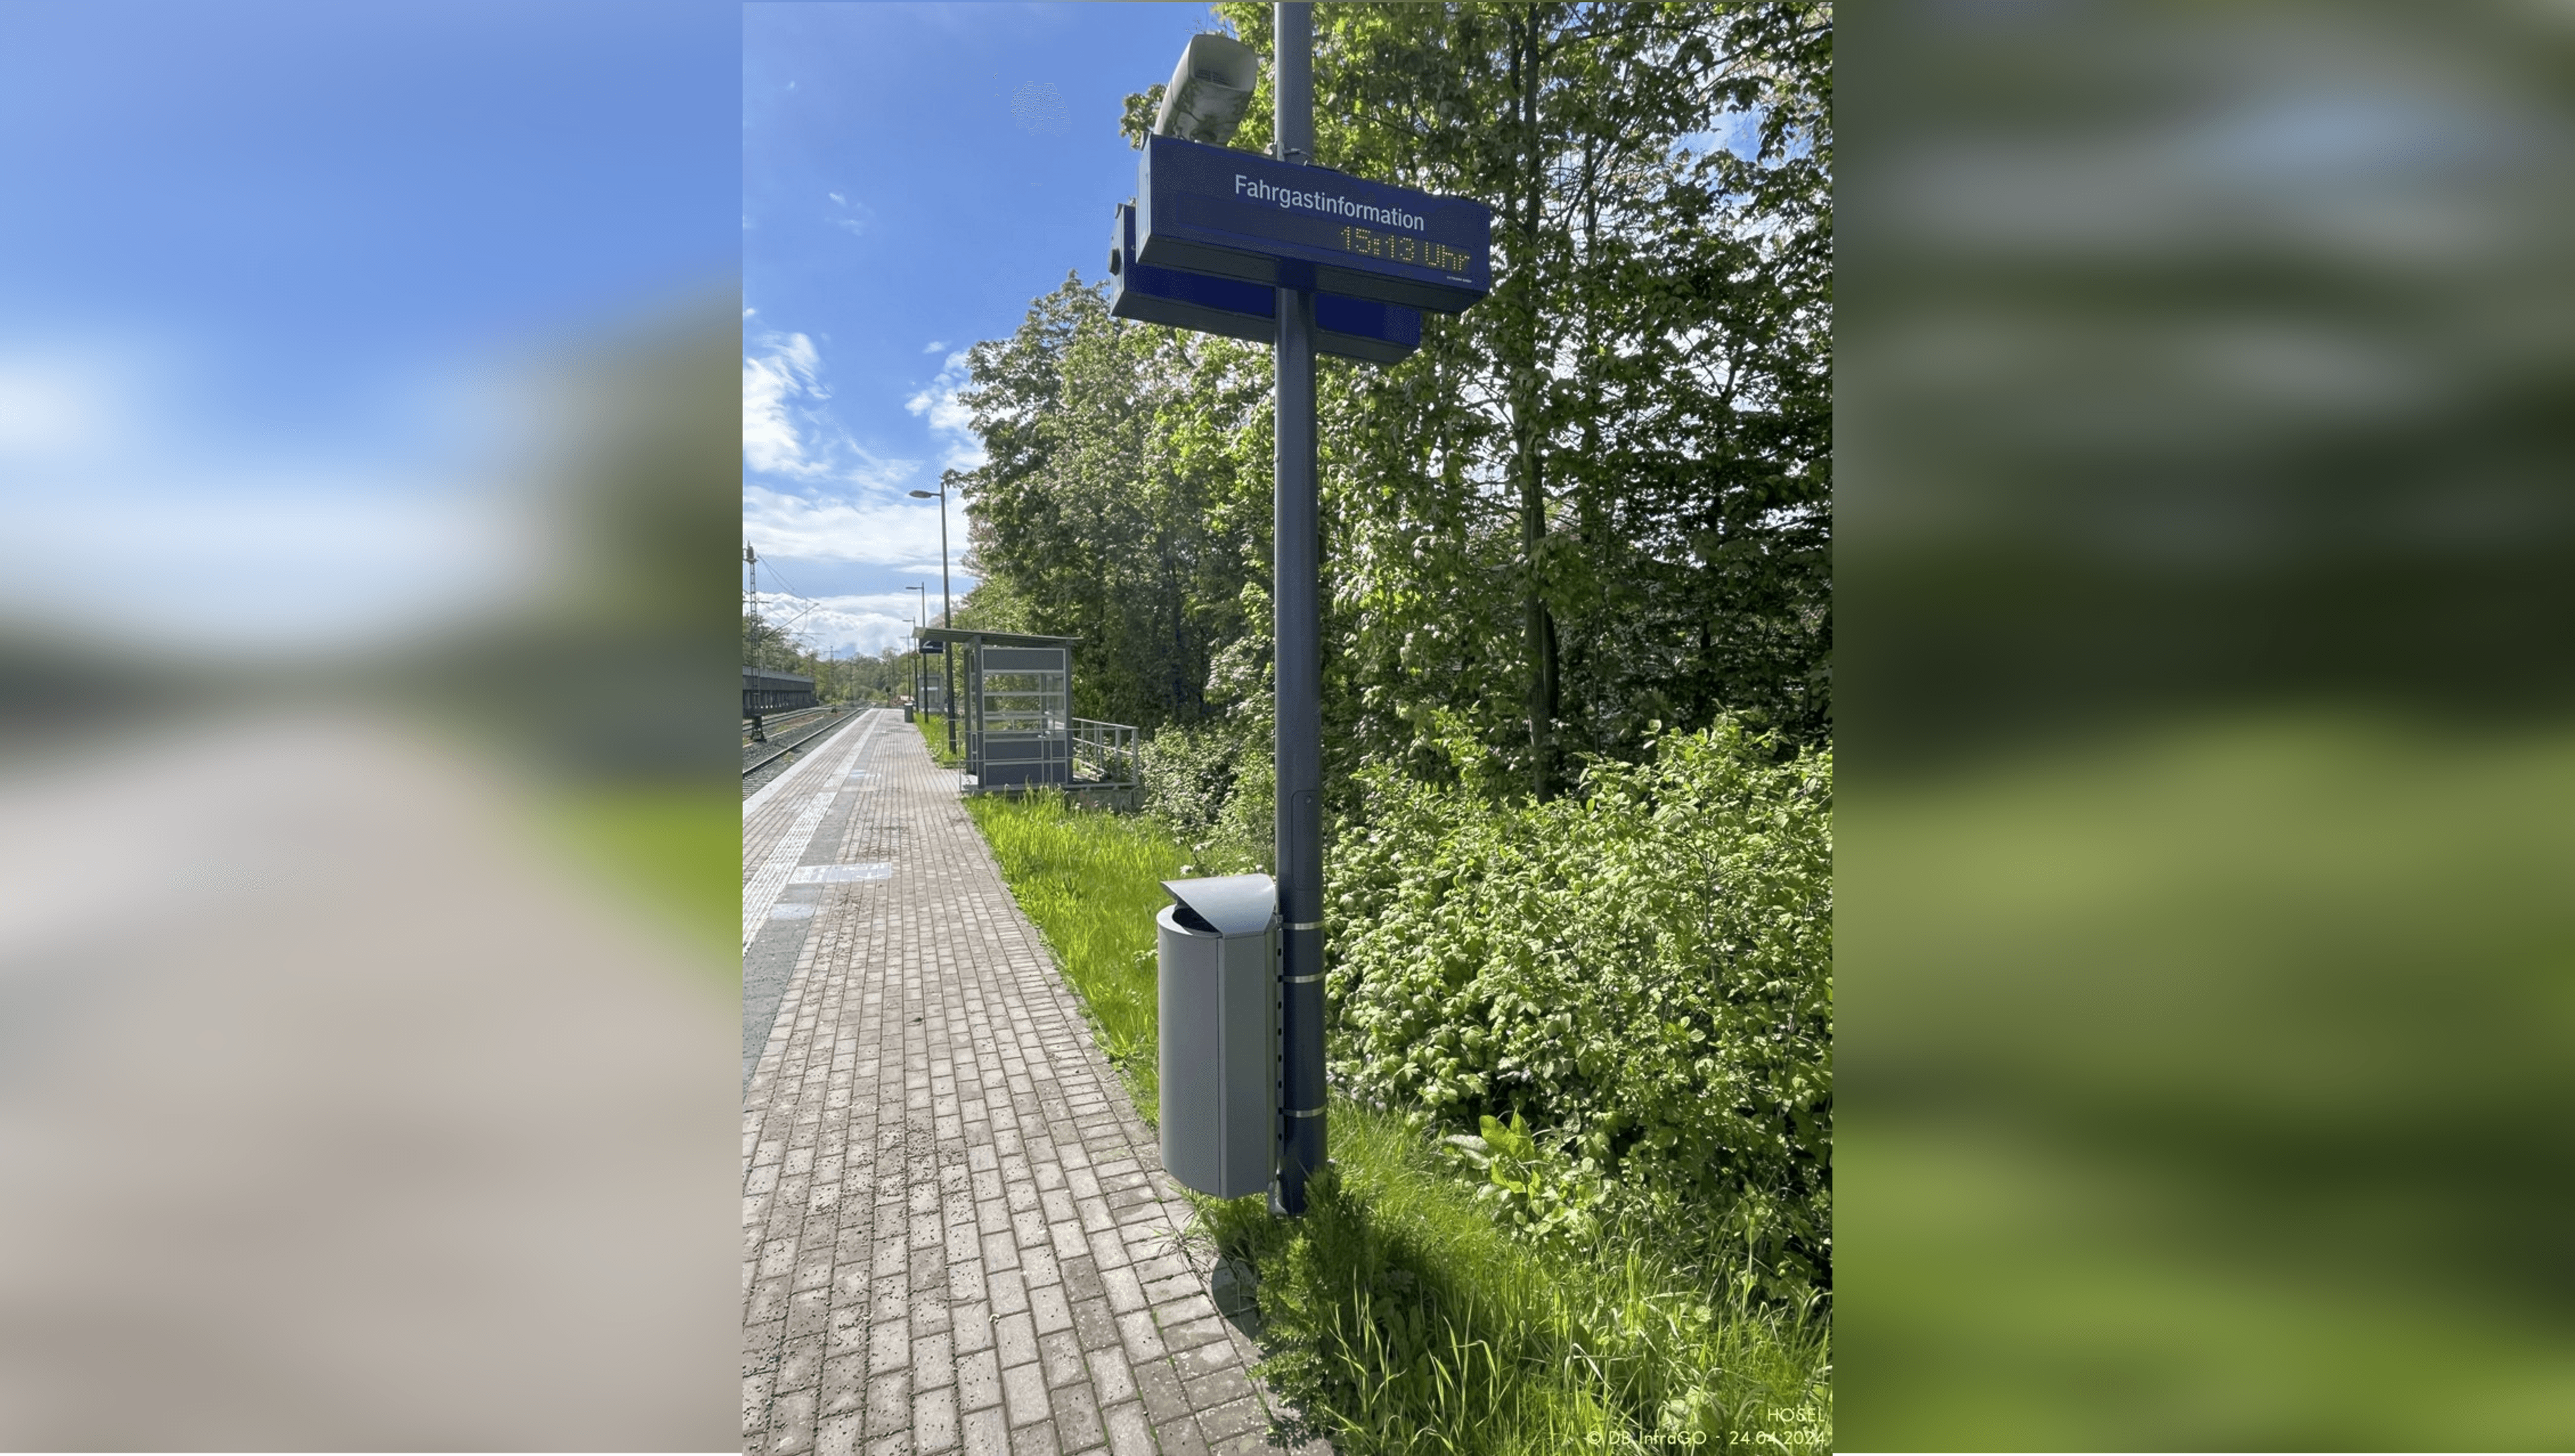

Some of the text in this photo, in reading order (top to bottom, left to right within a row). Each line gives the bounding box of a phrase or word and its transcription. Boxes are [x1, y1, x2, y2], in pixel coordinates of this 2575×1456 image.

[1235, 174, 1424, 231] Fahrgastinformation
[1340, 225, 1472, 271] 15:13 Uhr
